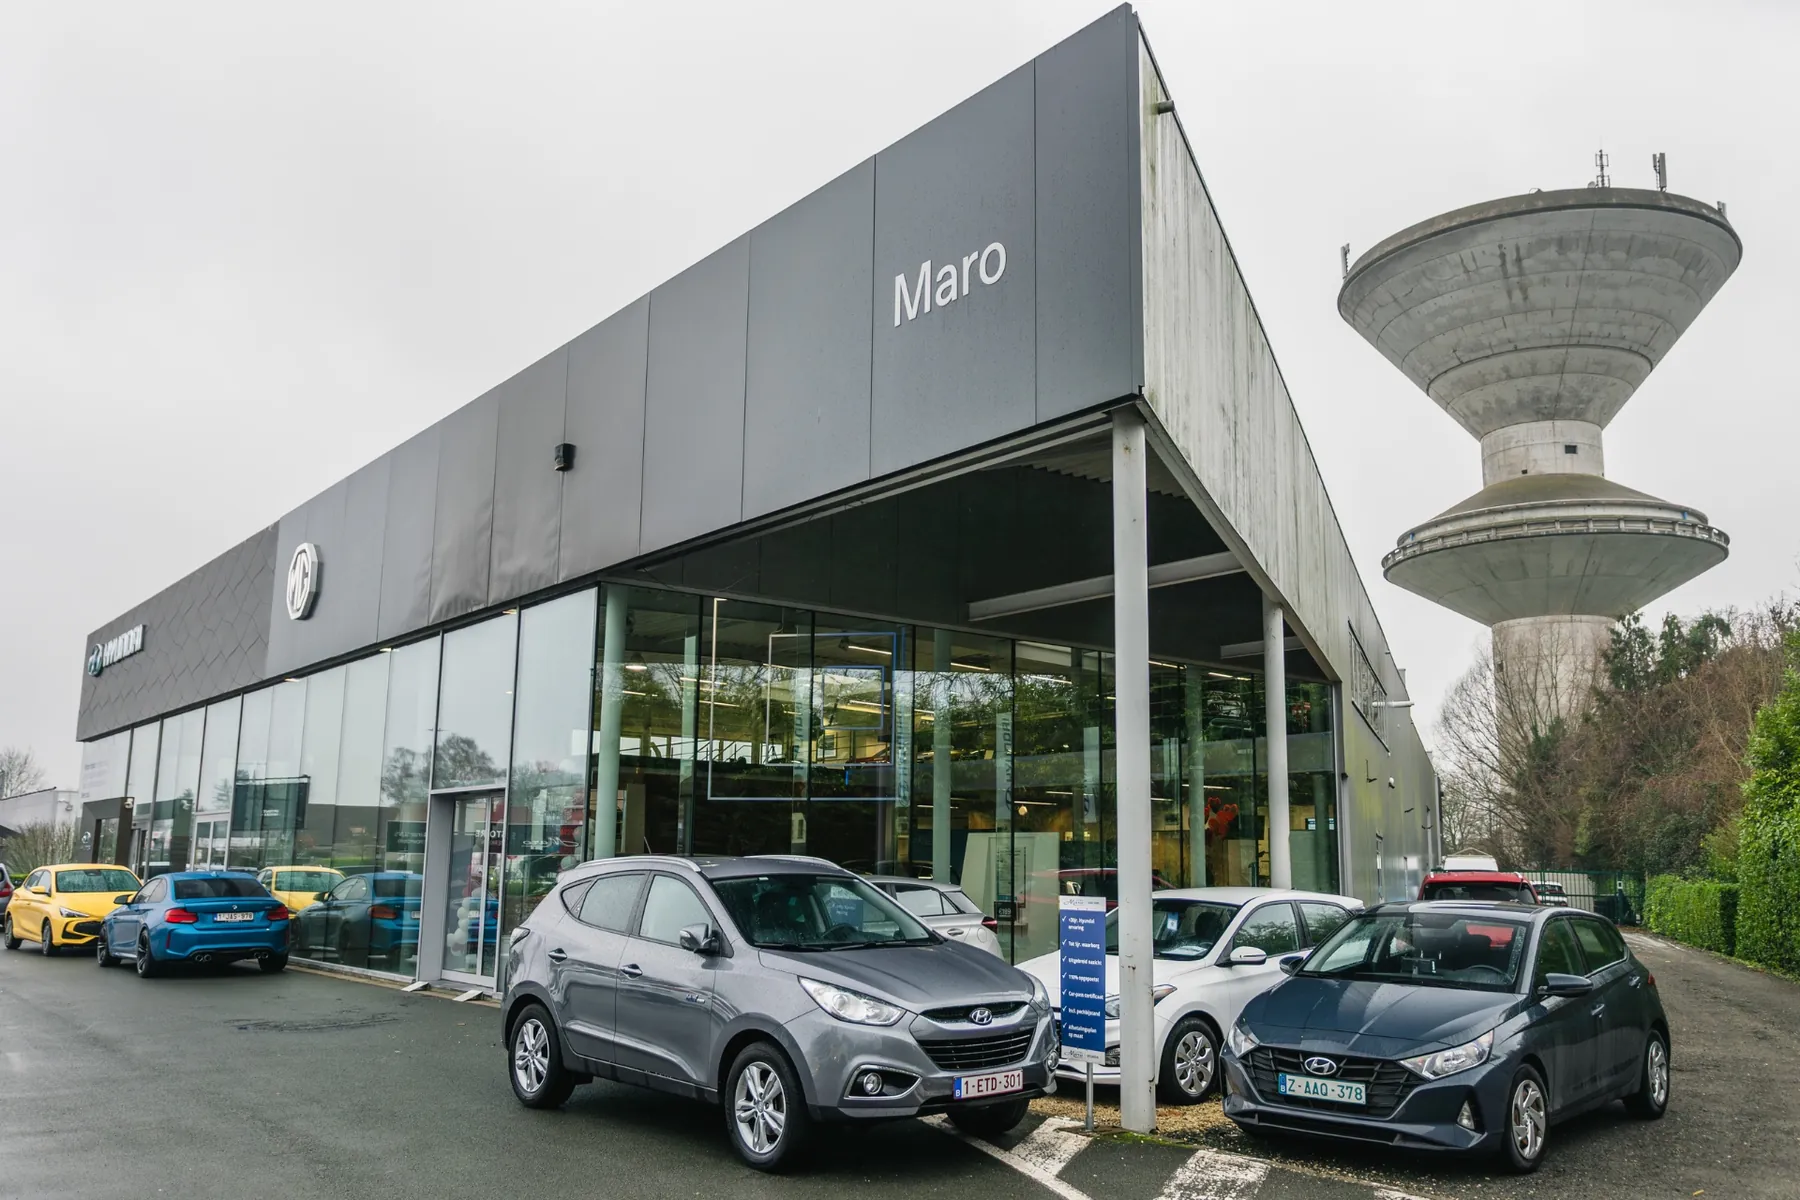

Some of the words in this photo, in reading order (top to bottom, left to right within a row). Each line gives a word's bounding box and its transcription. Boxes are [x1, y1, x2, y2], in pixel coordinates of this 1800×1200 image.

[894, 242, 1006, 328] Maro
[289, 549, 310, 612] MG
[955, 1089, 961, 1097] B
[964, 1073, 1021, 1095] 1-ETD-301
[1288, 1078, 1363, 1101] Z-AAQ-378
